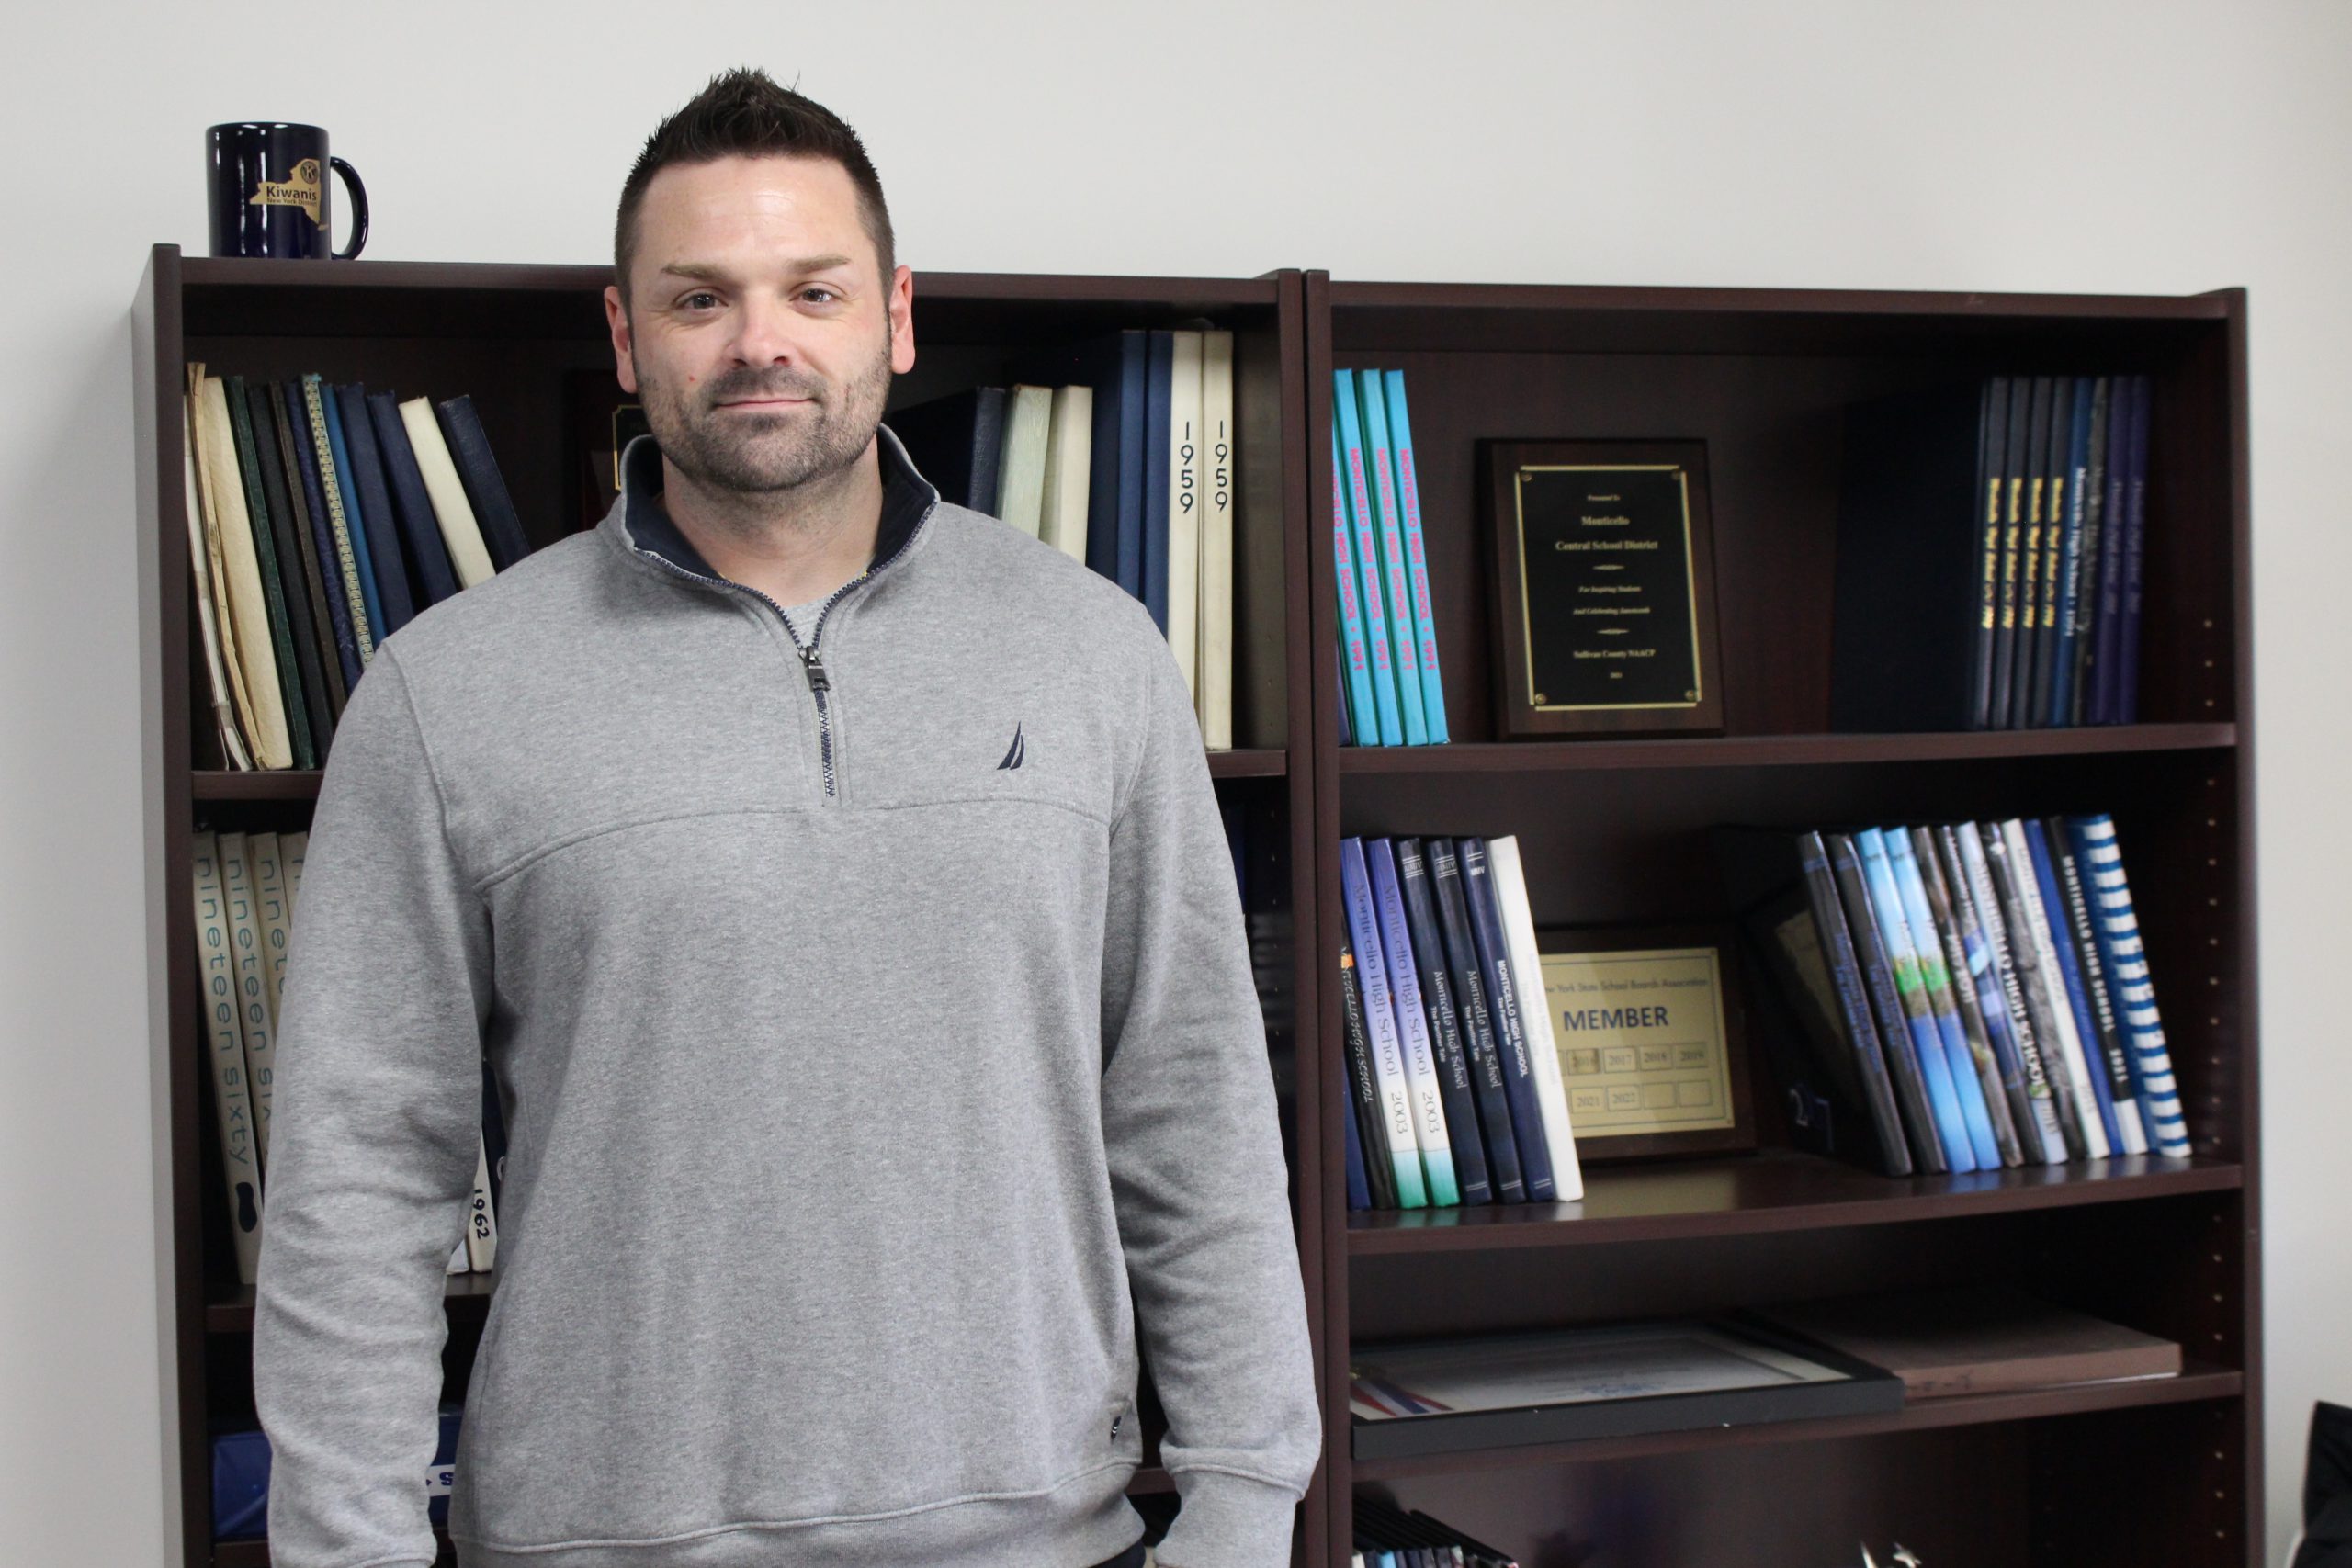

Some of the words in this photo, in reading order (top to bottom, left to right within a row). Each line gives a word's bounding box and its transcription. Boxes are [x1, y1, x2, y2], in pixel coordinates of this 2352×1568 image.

[266, 186, 317, 200] Kiwanis
[1180, 421, 1194, 514] 1959
[1215, 420, 1228, 513] 1959
[1351, 448, 1369, 527] MONTICELLO
[1377, 448, 1396, 527] MONTICELLO
[1400, 449, 1418, 528] MONTICELLO
[1581, 516, 1630, 525] Monticello
[1336, 532, 1350, 564] HIGH
[1361, 532, 1374, 563] HIGH
[1386, 532, 1400, 564] HIGH
[1409, 532, 1422, 564] HIGH
[1555, 540, 1590, 550] Central
[1592, 540, 1623, 550] School
[1624, 539, 1658, 550] District
[1341, 570, 1356, 620] SCHOOL
[1366, 569, 1381, 619] SCHOOL
[1392, 570, 1407, 620] SCHOOL
[1414, 570, 1430, 620] SCHOOL
[2063, 854, 2090, 940] MONTICELLO
[1354, 886, 1379, 969] Monticello
[227, 858, 268, 1052] nineteen
[2083, 942, 2100, 977] HIGH
[1369, 975, 1388, 1015] High
[1434, 971, 1453, 1026] Monticello
[1466, 970, 1488, 1025] Monticello
[1498, 961, 1518, 1018] MONTICELLO
[1600, 981, 1628, 991] School
[197, 857, 235, 1051] nineteen
[224, 1066, 249, 1165] sixty
[1384, 885, 1409, 970] Monticello
[1398, 975, 1418, 1014] High
[1408, 1018, 1431, 1076] School
[1420, 1090, 1442, 1134] 2003
[1430, 1006, 1439, 1019] The
[1464, 1006, 1473, 1018] The
[1563, 1006, 1668, 1031] MEMBER
[2091, 979, 2115, 1032] SCHOOL
[1377, 1018, 1399, 1077] School
[1431, 1021, 1445, 1047] Panther
[1445, 1028, 1461, 1053] High
[1464, 1018, 1479, 1046] Panther
[1478, 1027, 1493, 1052] High
[1510, 1018, 1523, 1040] HIGH
[2001, 970, 2026, 1018] HIGH
[2015, 1019, 2045, 1087] SCHOOL
[1437, 1047, 1448, 1063] Tale
[1452, 1056, 1467, 1089] School
[1472, 1047, 1481, 1061] Tale
[1485, 1055, 1501, 1088] School
[1513, 1041, 1531, 1078] SCHOOL
[1389, 1090, 1410, 1134] 2003
